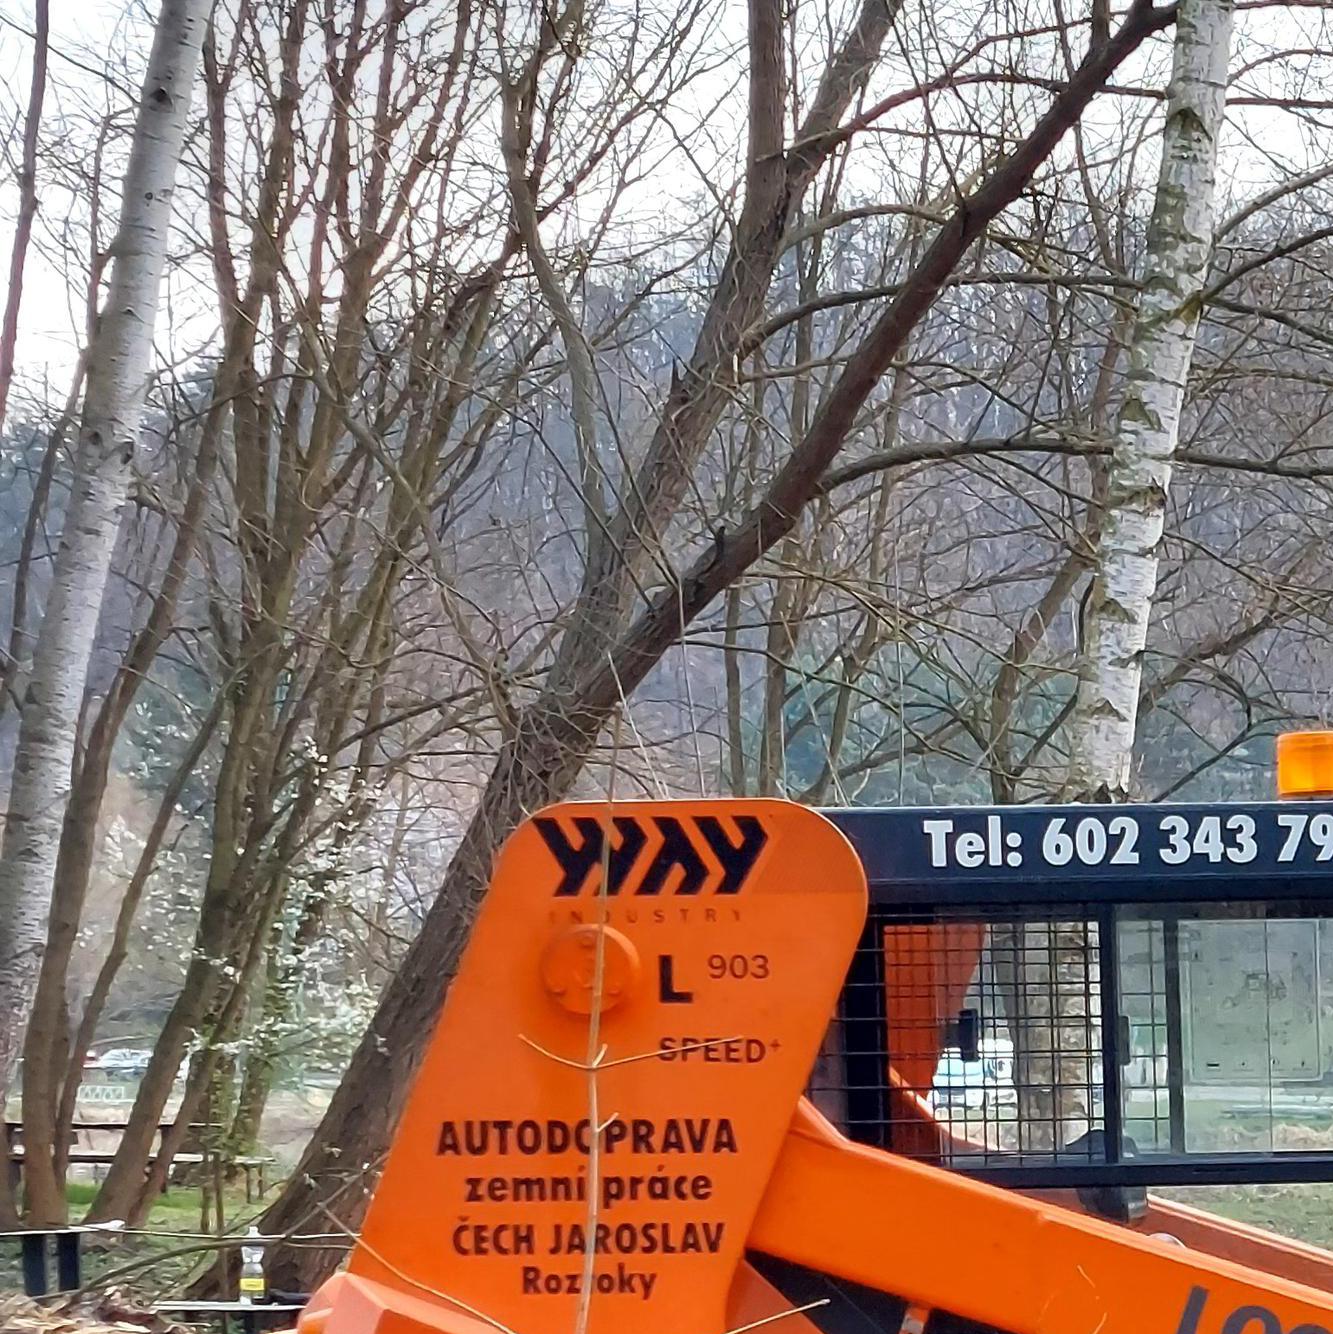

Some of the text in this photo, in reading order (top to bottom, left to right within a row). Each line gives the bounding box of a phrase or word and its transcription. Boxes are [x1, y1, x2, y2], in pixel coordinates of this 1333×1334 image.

[923, 816, 1024, 868] Tel:
[1042, 818, 1140, 865] 602
[1159, 815, 1258, 864] 343
[659, 954, 770, 1003] L 903
[465, 1164, 713, 1209] zemní práce
[452, 1216, 725, 1256] ČECH JAROSLAV
[522, 1262, 657, 1300] Rozoky
